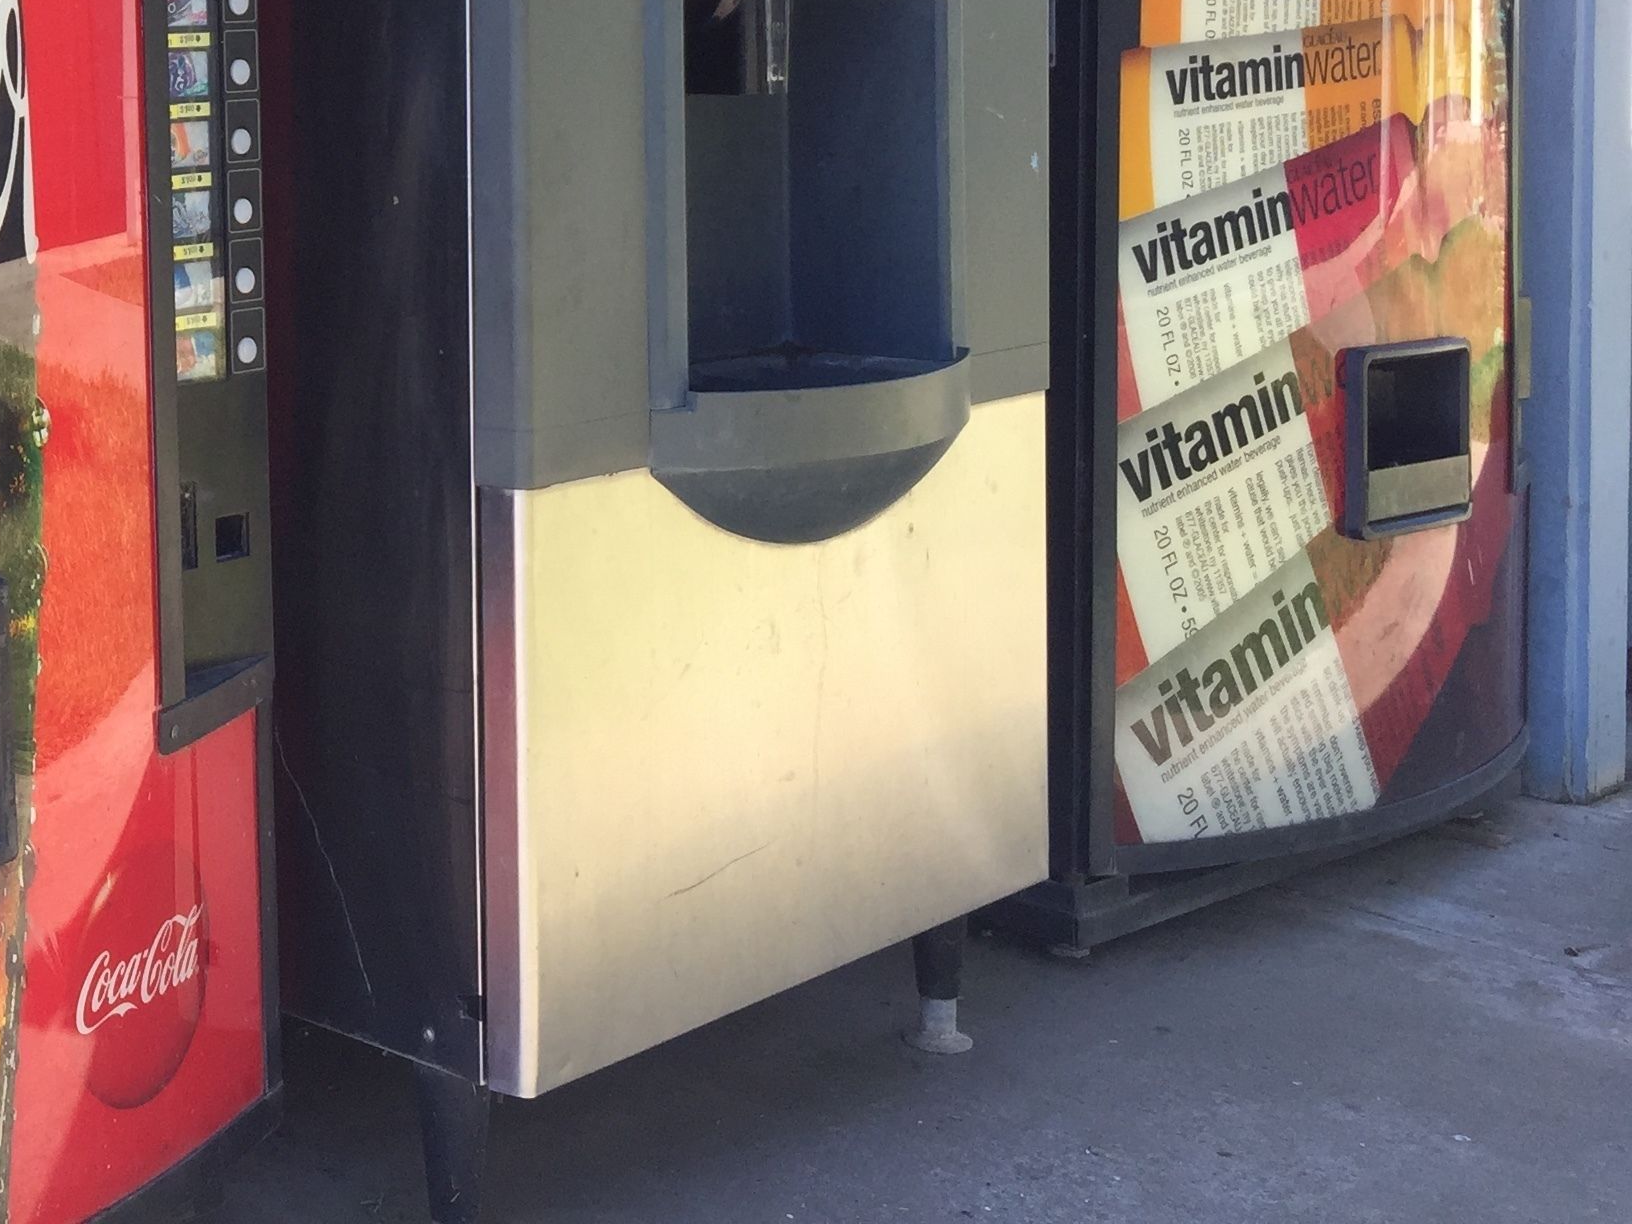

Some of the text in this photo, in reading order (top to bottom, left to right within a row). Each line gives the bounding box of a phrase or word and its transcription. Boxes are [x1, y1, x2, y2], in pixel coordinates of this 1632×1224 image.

[1206, 9, 1216, 29] FL
[1178, 128, 1194, 189] 20 FL OZ
[1155, 306, 1183, 377] 20 FL OZ
[1231, 332, 1246, 358] water
[1141, 435, 1282, 518] nutrient enhanced water beverage
[1242, 477, 1276, 557] cause that would
[1152, 525, 1173, 550] 20
[1160, 551, 1181, 575] FL
[1241, 540, 1259, 569] water
[1167, 576, 1190, 603] OZ
[1327, 735, 1345, 762] don't
[1174, 786, 1201, 817] 20
[1274, 786, 1294, 818] water
[75, 903, 204, 1035] Coca-Cola
